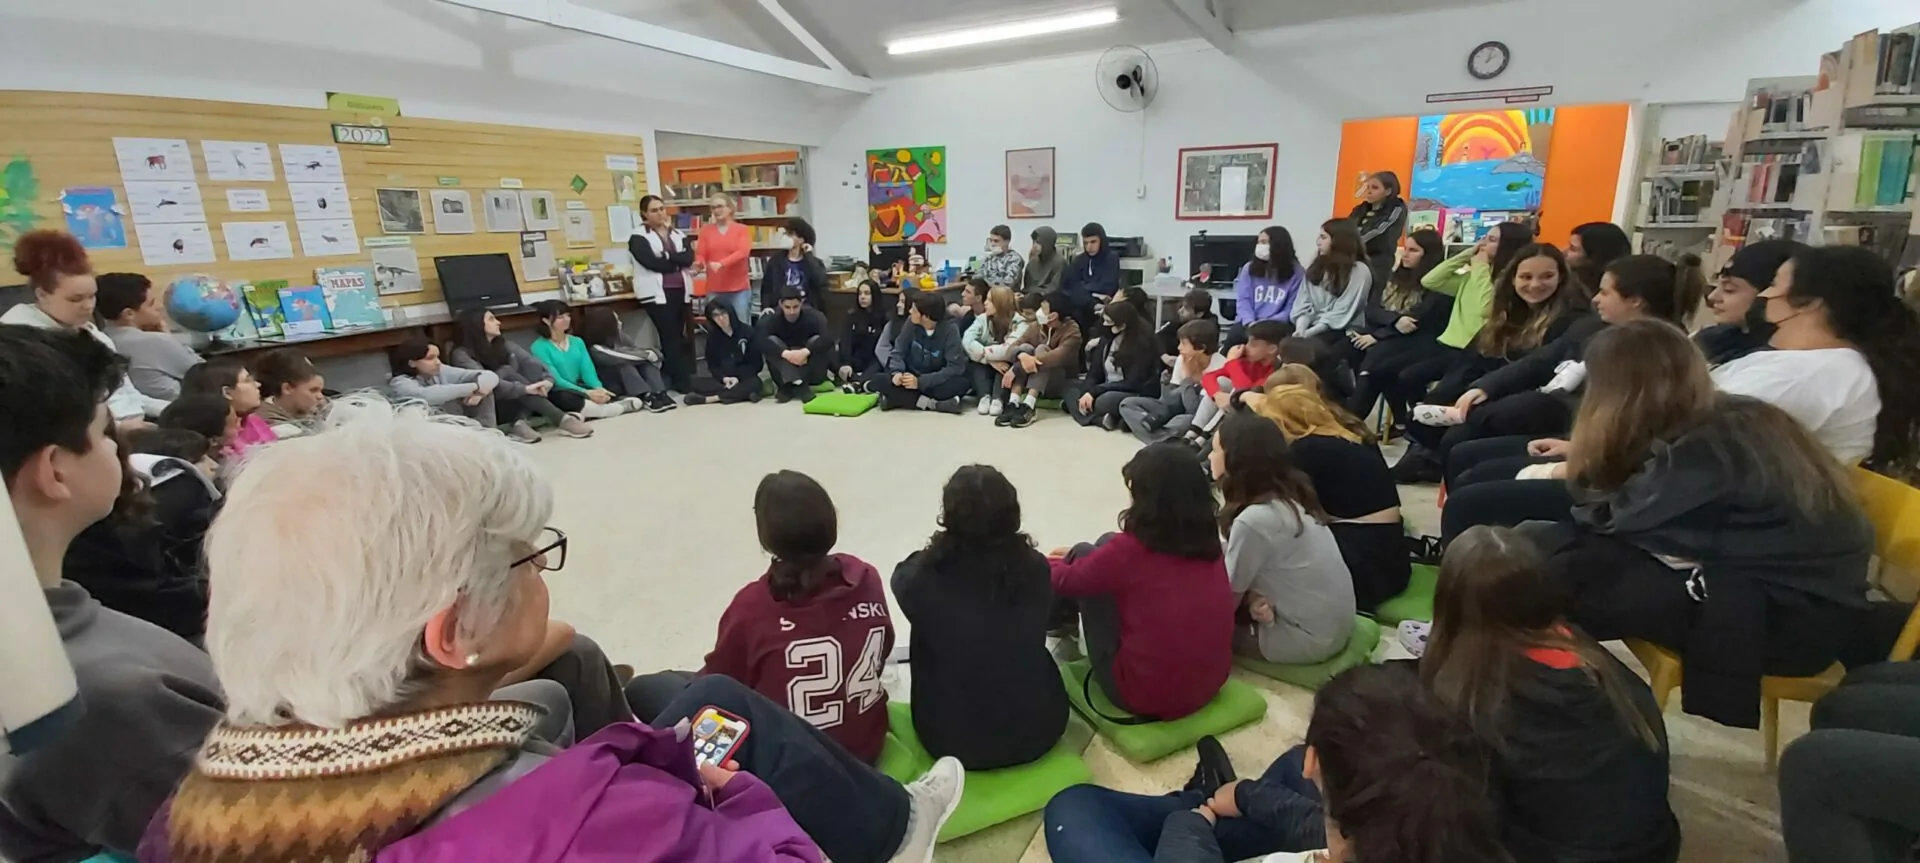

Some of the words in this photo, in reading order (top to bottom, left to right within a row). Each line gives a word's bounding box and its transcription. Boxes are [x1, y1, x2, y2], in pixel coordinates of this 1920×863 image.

[340, 127, 383, 144] 2022
[330, 277, 365, 289] MAPAS
[1254, 284, 1286, 305] GAP
[785, 626, 886, 730] 24
